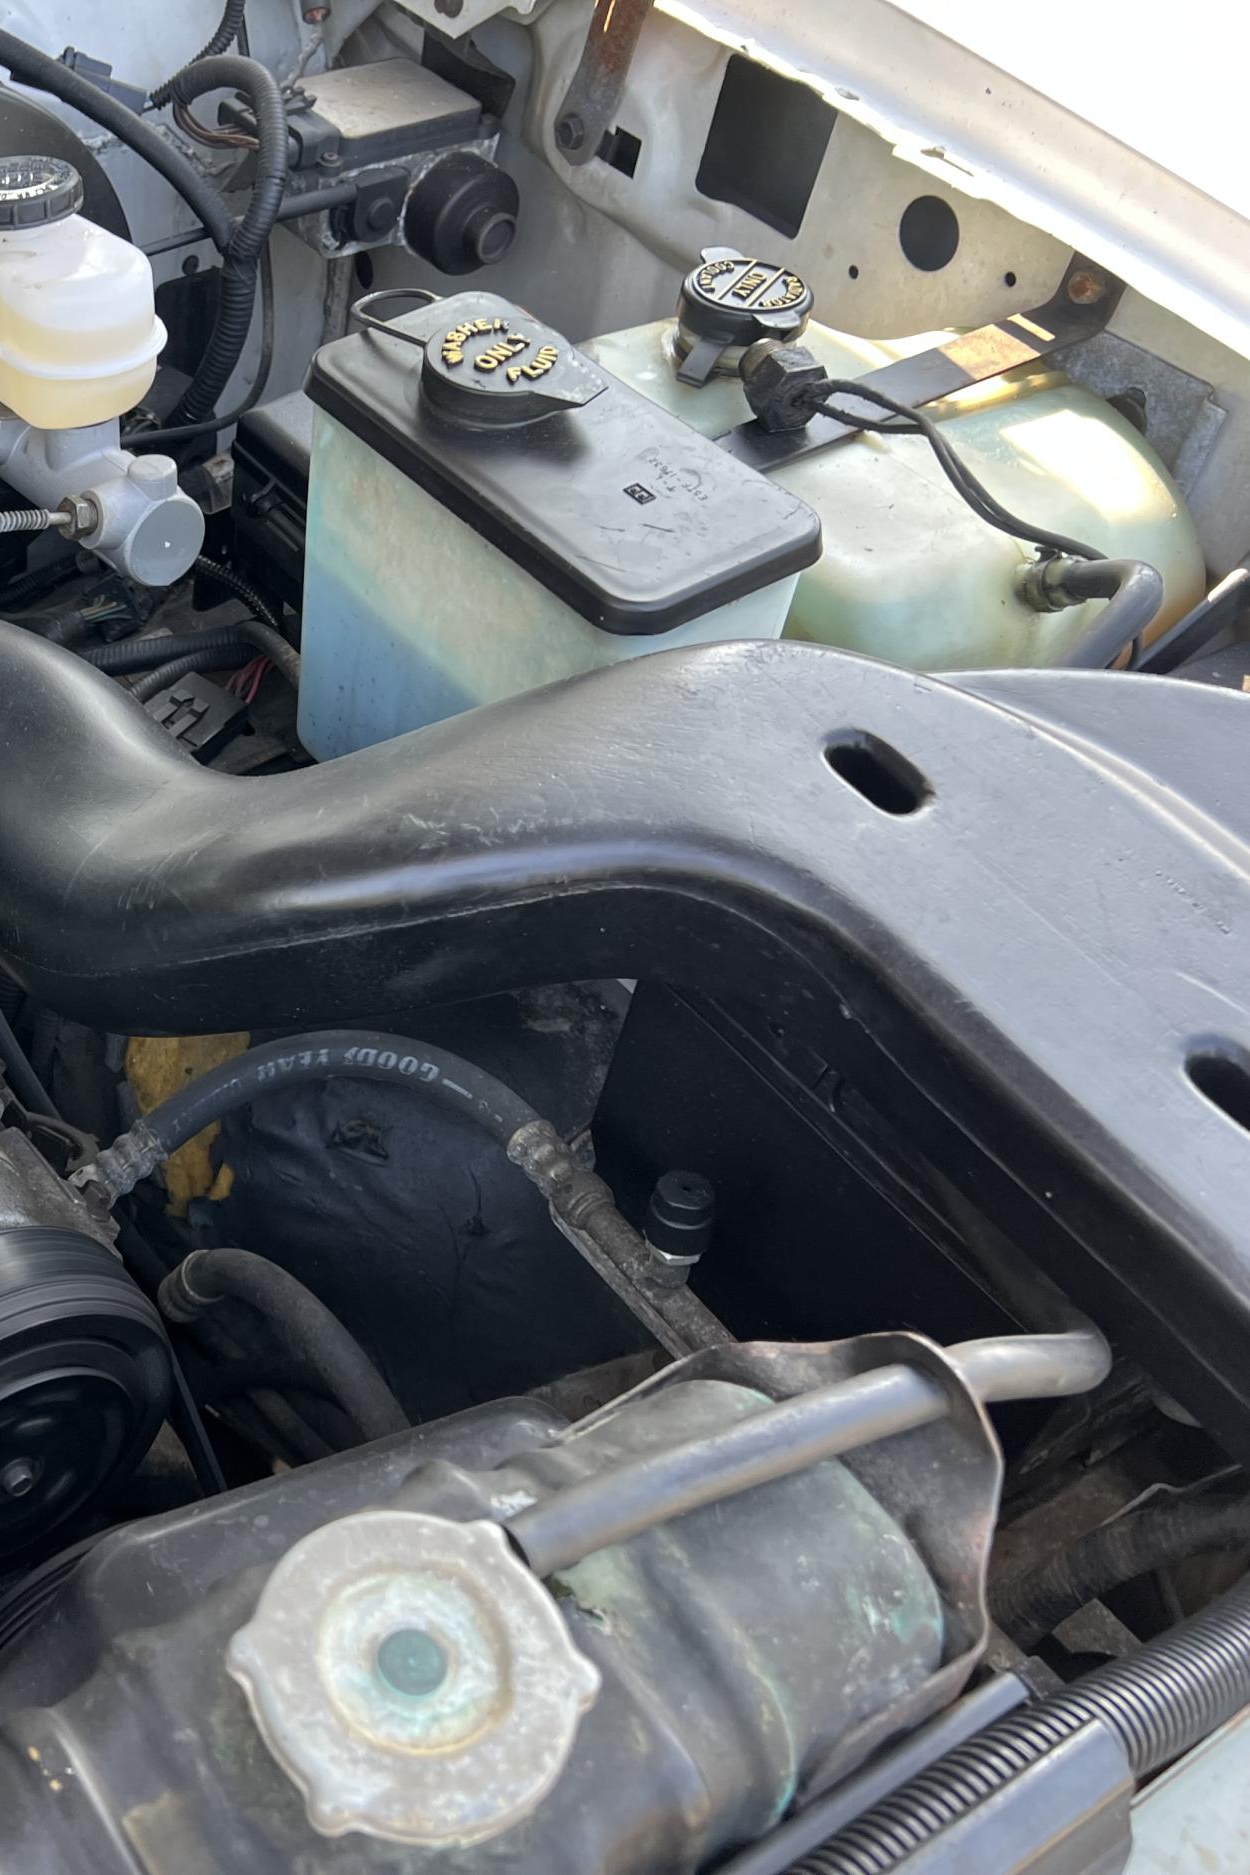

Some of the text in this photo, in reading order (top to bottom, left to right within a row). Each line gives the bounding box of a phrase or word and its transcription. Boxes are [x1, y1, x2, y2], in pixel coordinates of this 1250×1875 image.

[731, 271, 768, 300] ONLY
[442, 318, 510, 366] WASHER
[474, 332, 531, 371] ONLY
[506, 346, 558, 384] FLUID
